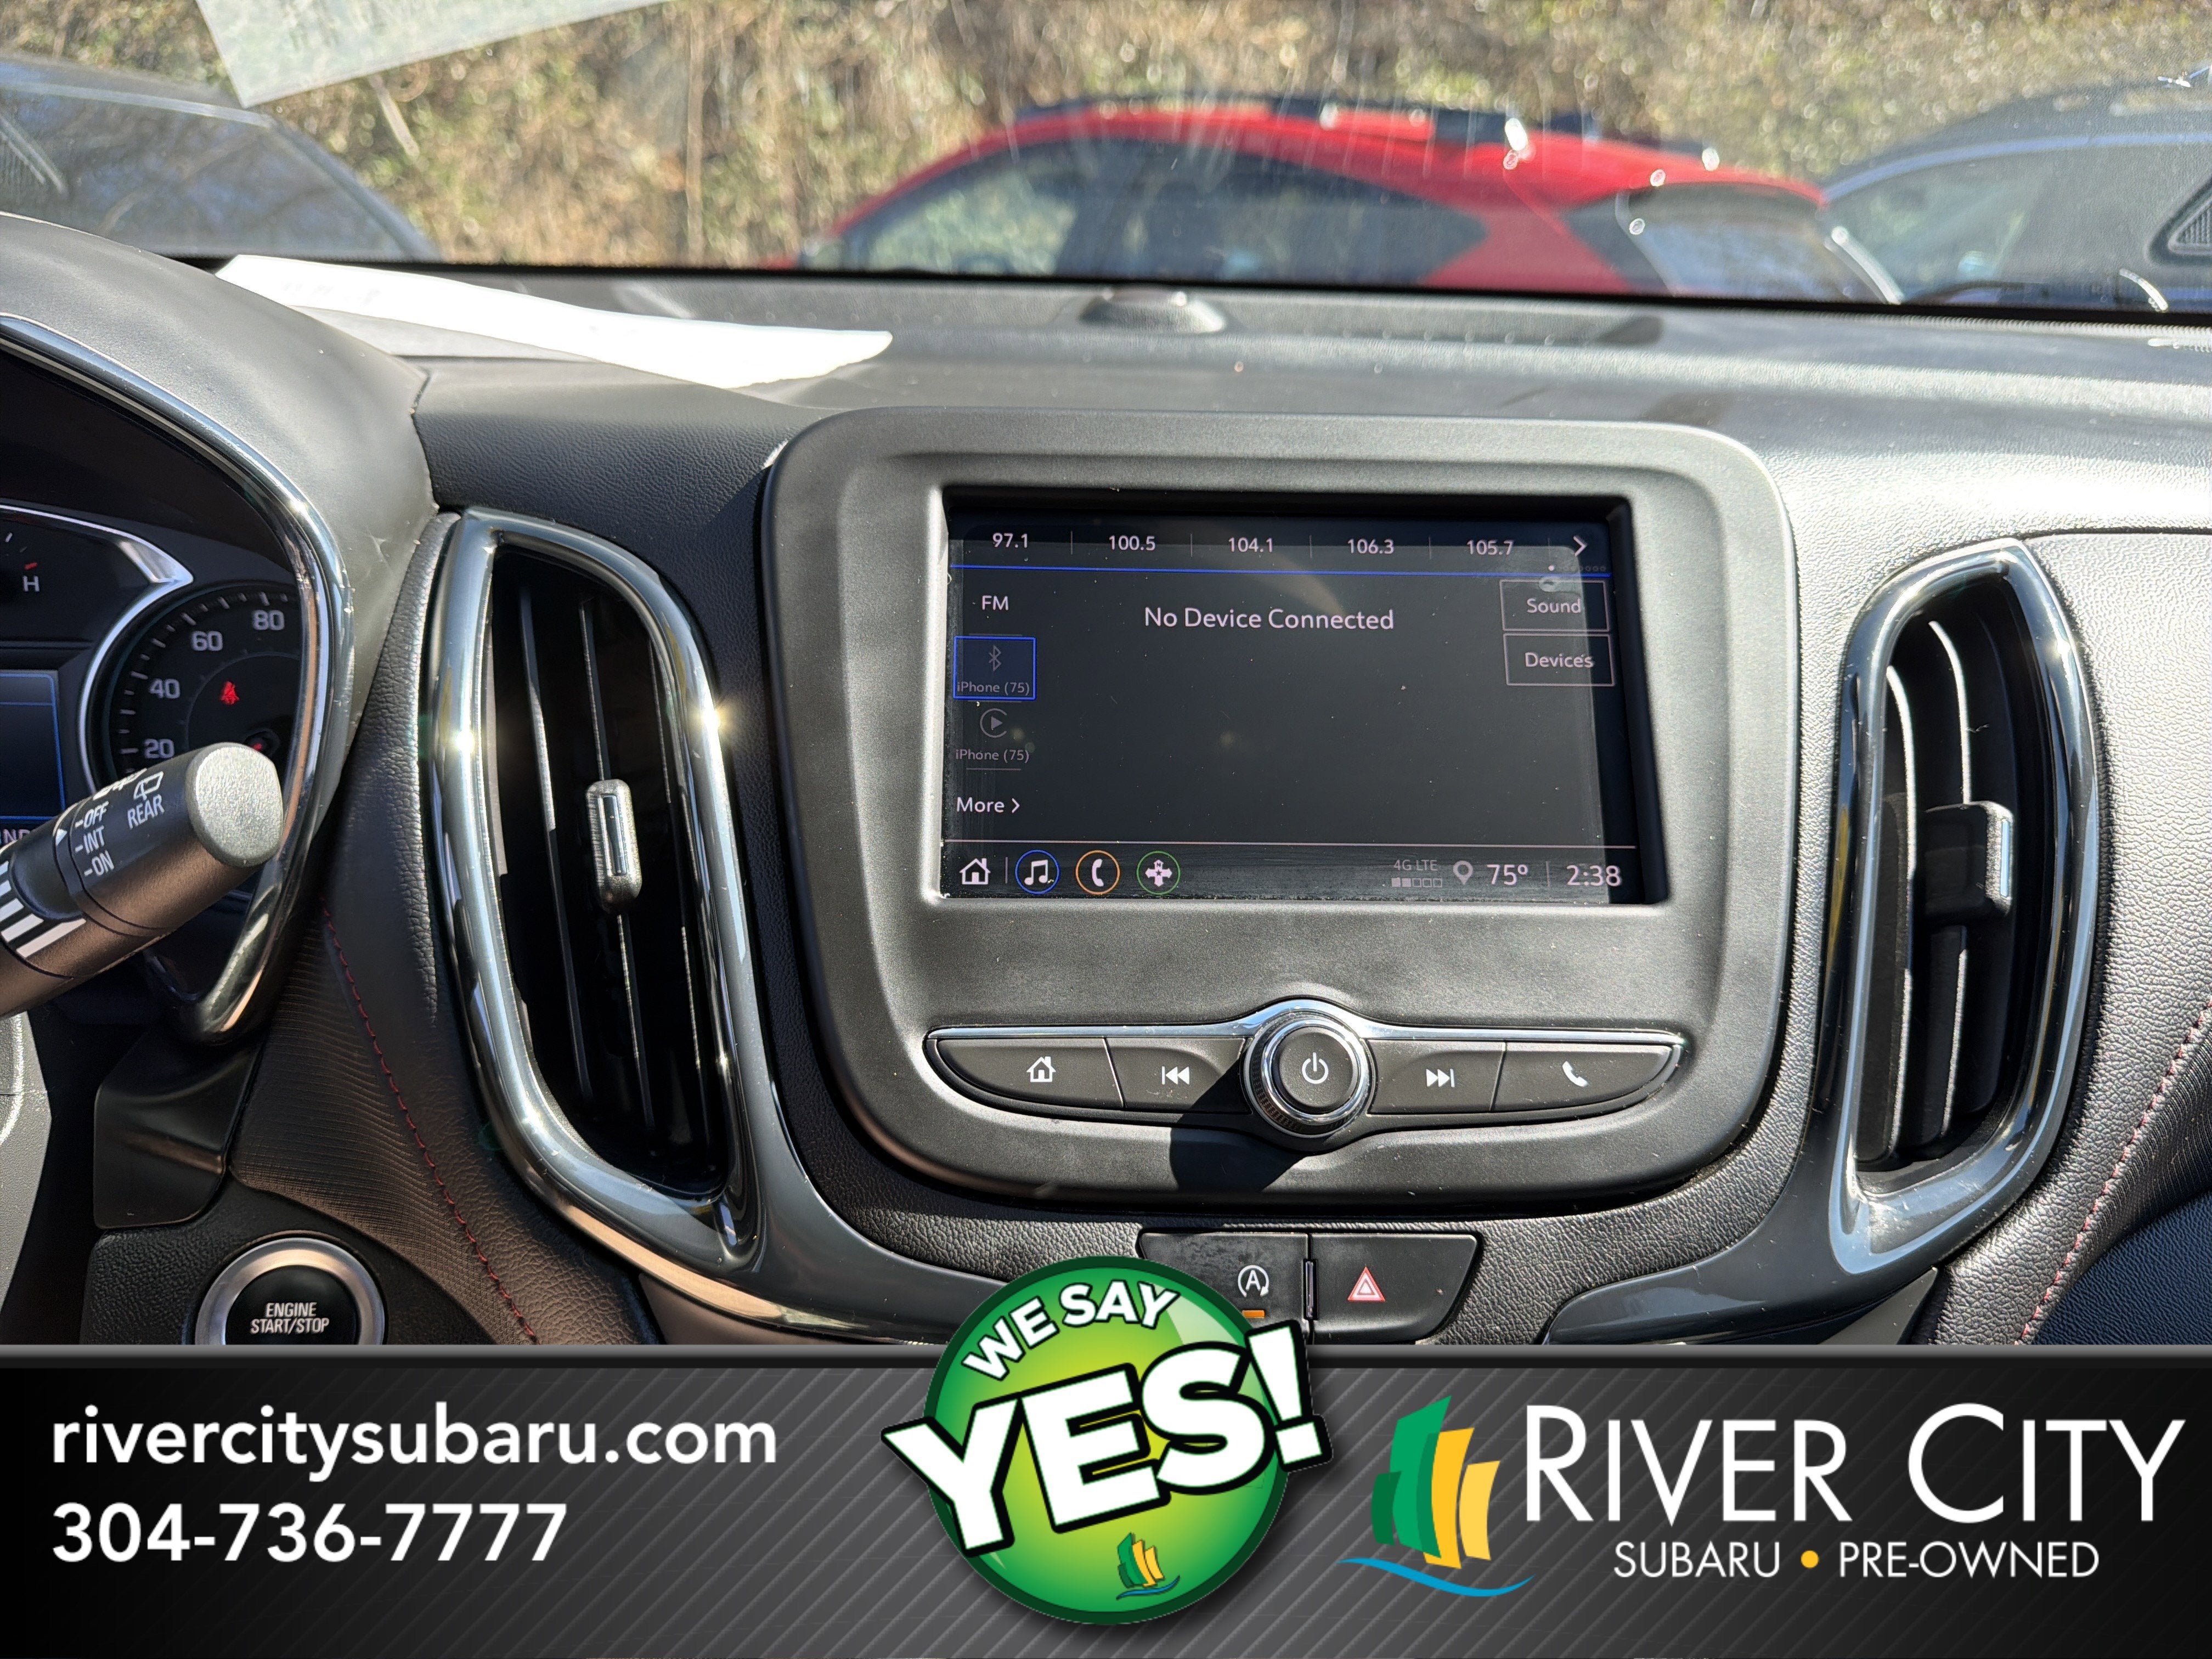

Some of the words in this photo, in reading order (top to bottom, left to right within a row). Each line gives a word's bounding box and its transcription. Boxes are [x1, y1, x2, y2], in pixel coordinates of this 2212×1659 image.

[992, 533, 1028, 548] 97.1
[1109, 535, 1155, 551] 100.5
[1228, 537, 1273, 552] 104.1
[1348, 539, 1394, 554] 106.3
[1467, 540, 1513, 555] 105.7
[22, 575, 40, 592] H
[981, 595, 1009, 611] FM
[1527, 598, 1582, 614] Sound
[252, 610, 285, 630] 80
[1145, 607, 1177, 627] No
[1185, 607, 1262, 628] Device
[1268, 608, 1394, 630] Connected
[191, 631, 223, 651] 60
[1525, 652, 1594, 668] Devices
[149, 679, 180, 699] 40
[957, 681, 1000, 693] iPhone
[1004, 682, 1030, 696] (75)
[144, 738, 175, 759] 20
[956, 749, 1000, 761] iPhone
[1003, 749, 1030, 764] (75)
[127, 794, 165, 830] REAR
[956, 797, 1005, 814] More
[1393, 859, 1412, 872] 4G
[1416, 859, 1438, 872] LTE
[1566, 865, 1622, 888] 2:38
[265, 1302, 318, 1318] ENGINE
[250, 1317, 330, 1335] START/STOP
